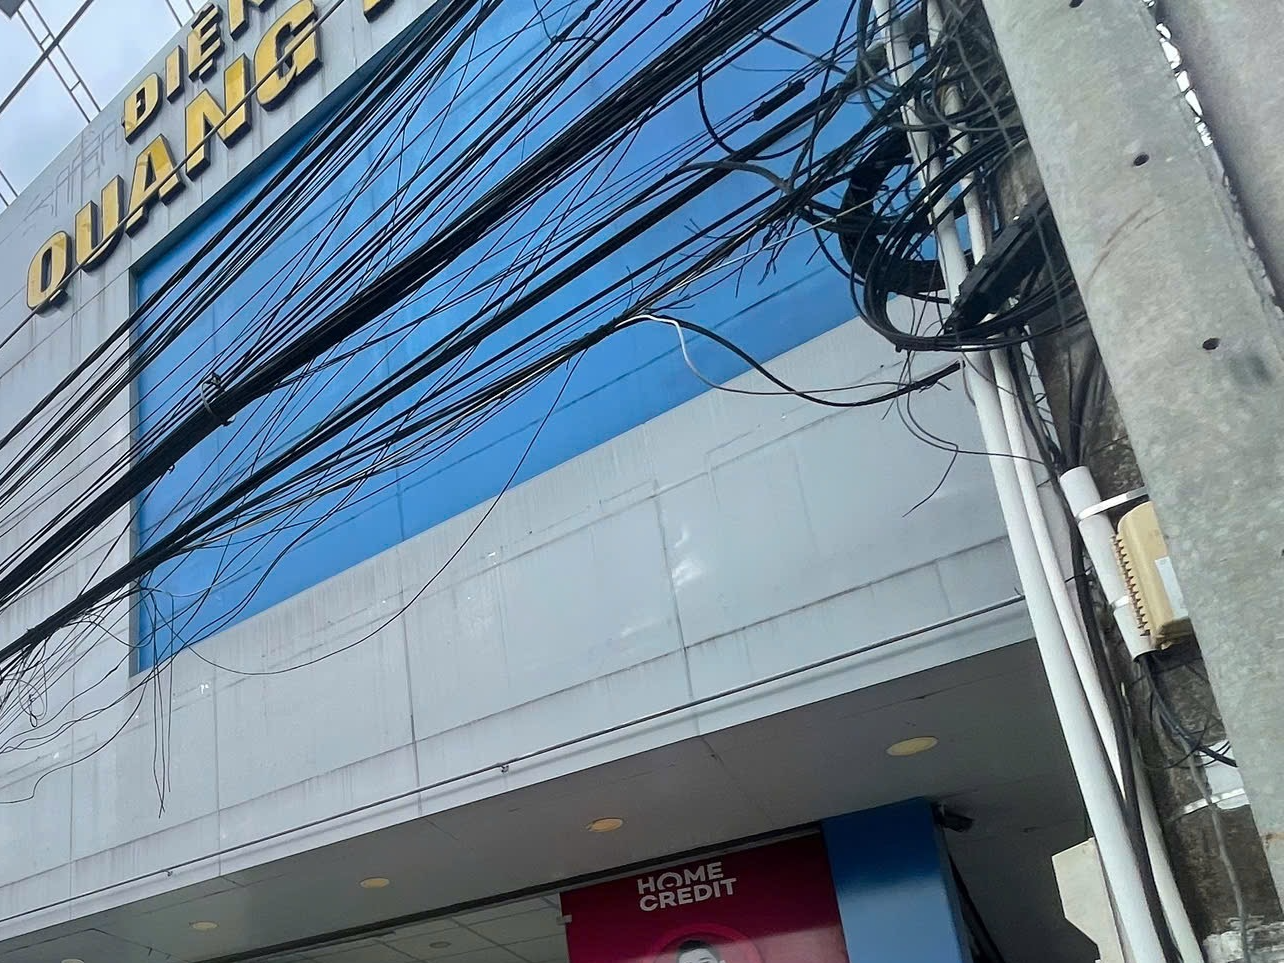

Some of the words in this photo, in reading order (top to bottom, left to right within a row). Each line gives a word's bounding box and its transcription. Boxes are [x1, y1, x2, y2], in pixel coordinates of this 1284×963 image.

[27, 0, 322, 314] QUANG
[637, 861, 724, 895] HOME
[639, 878, 737, 912] CREDIT
